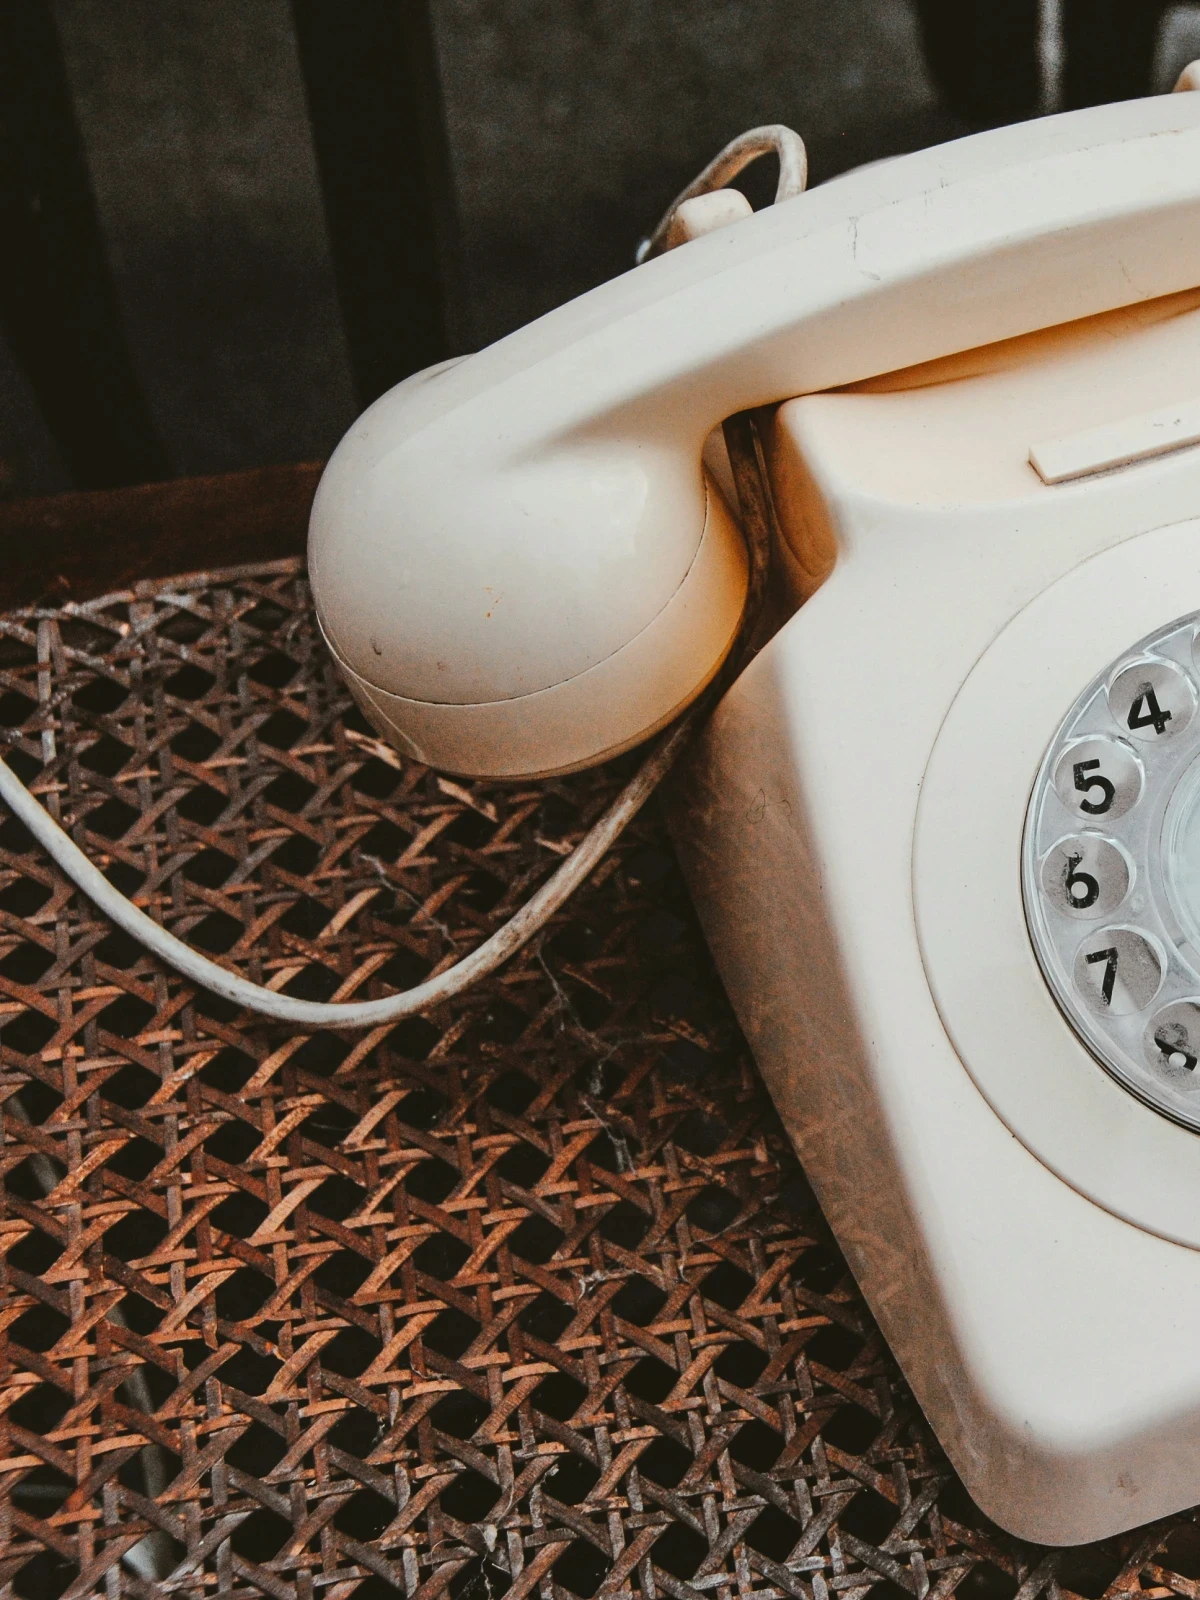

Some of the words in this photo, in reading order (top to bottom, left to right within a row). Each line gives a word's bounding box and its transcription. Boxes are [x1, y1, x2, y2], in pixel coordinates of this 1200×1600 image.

[1127, 681, 1173, 735] 4
[1072, 759, 1116, 814] 5
[1064, 851, 1099, 908] 6
[1085, 946, 1118, 1007] 7
